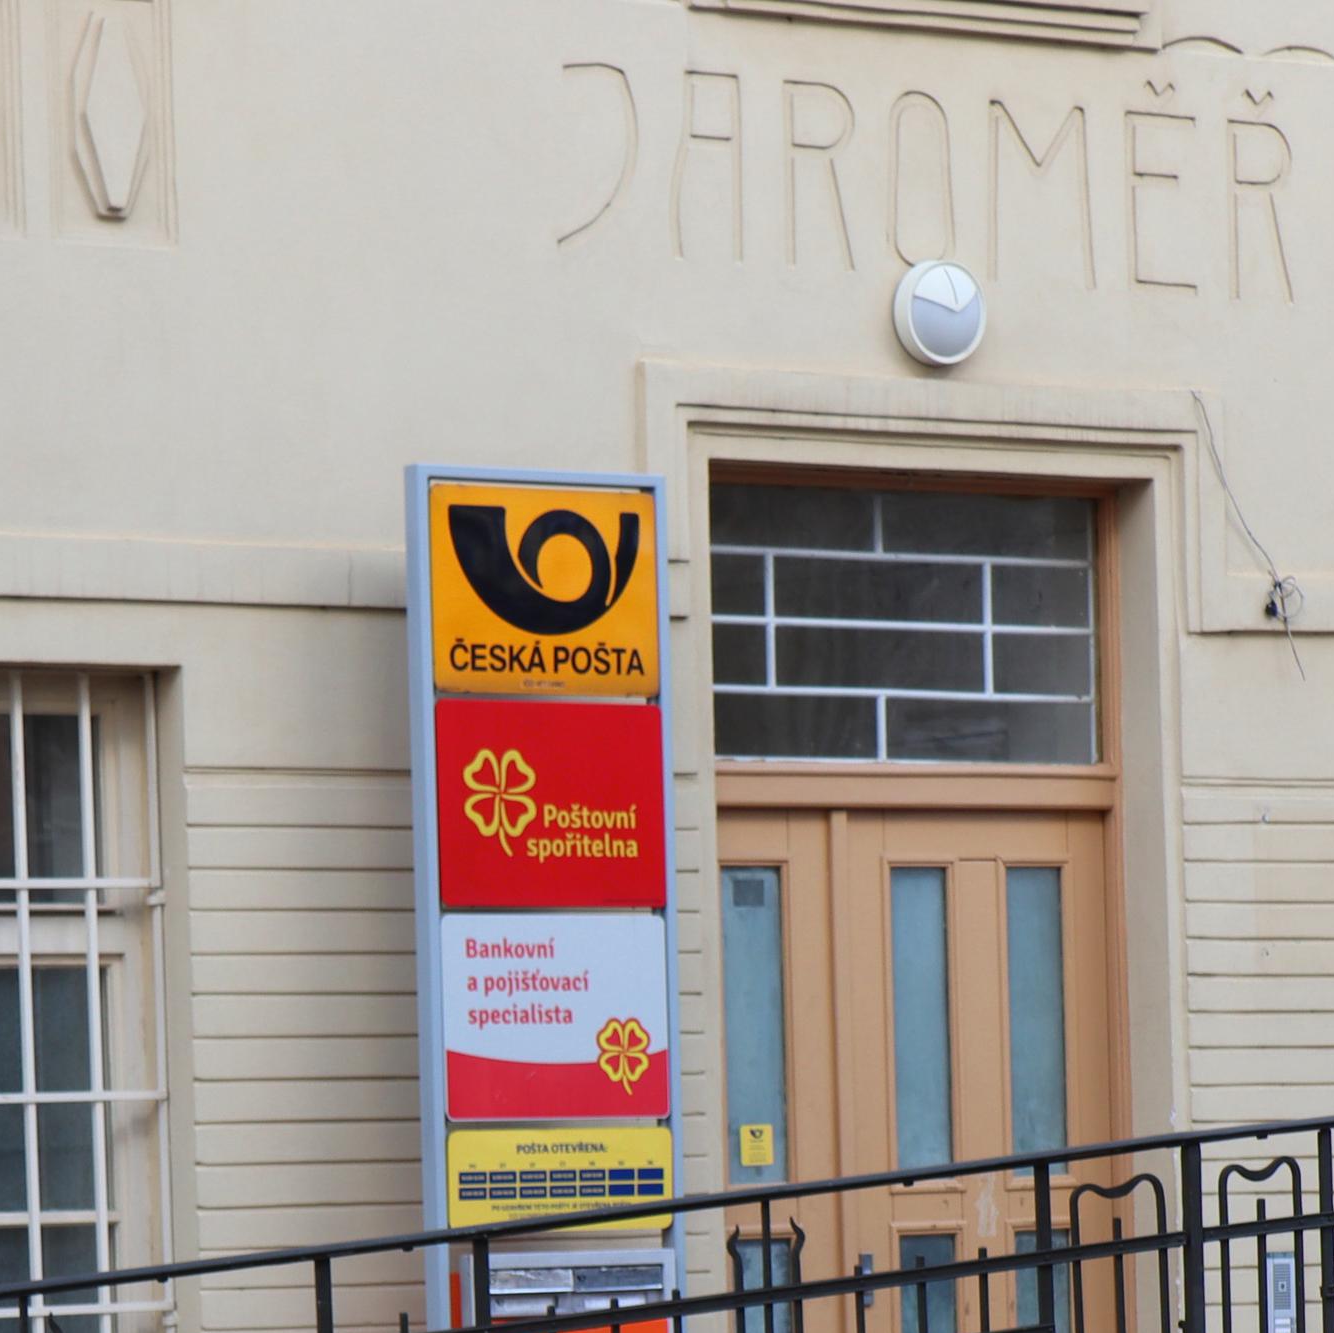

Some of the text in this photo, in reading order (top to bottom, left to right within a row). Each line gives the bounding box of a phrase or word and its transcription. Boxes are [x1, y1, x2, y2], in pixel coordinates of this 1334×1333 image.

[558, 63, 1295, 305] JAROMĚŘ
[450, 639, 644, 675] ČESKÁ POŠTA
[544, 804, 636, 829] Poštovní
[527, 834, 638, 861] spořitelna
[466, 938, 554, 958] Bankovní
[468, 970, 588, 996] a pojišťovací
[468, 1004, 572, 1029] specialista
[516, 1142, 548, 1154] POŠTA
